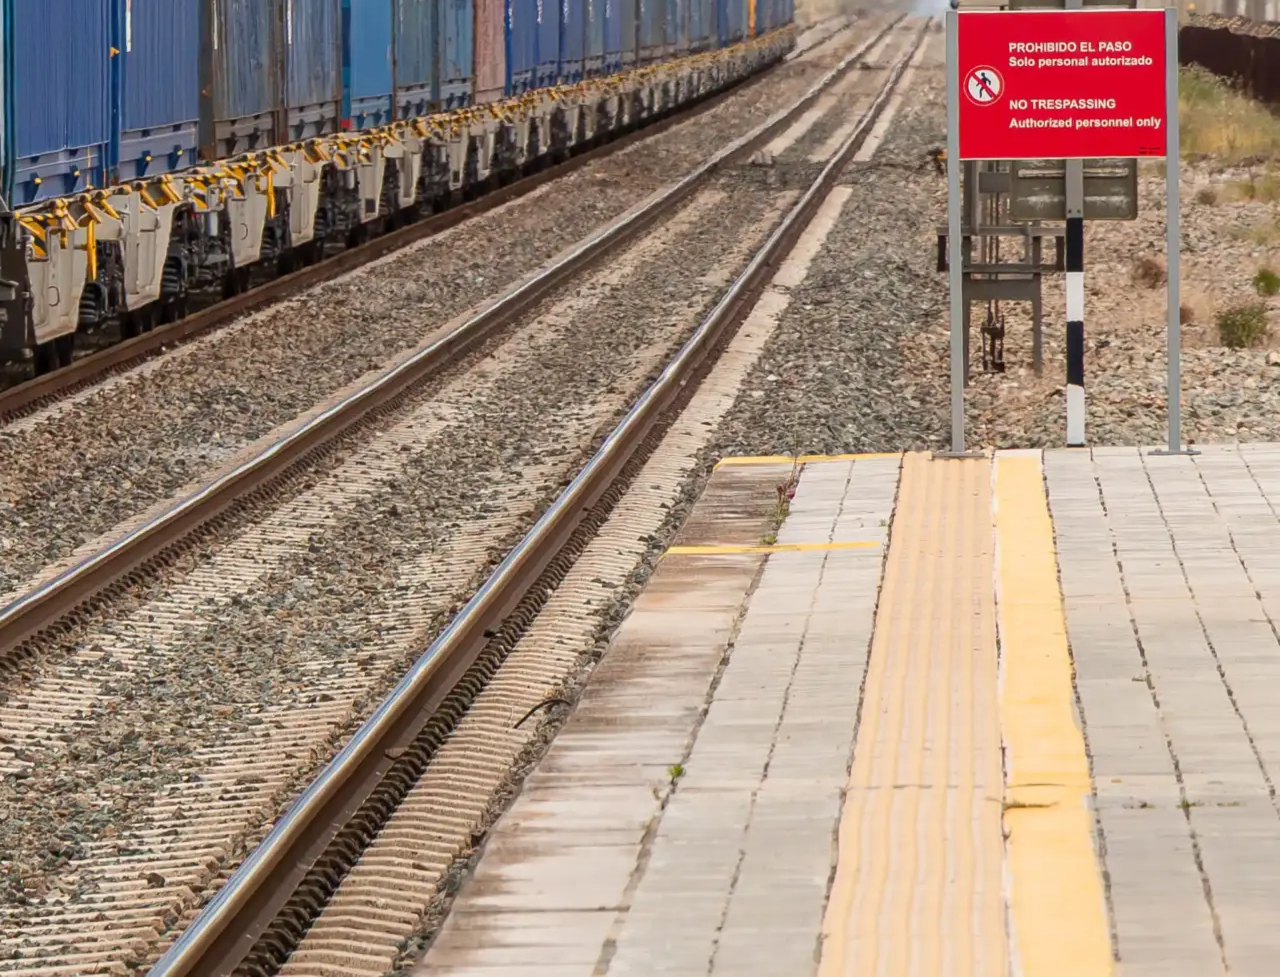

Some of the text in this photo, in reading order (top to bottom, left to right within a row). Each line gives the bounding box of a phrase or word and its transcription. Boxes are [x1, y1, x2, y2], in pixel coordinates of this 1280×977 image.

[1008, 40, 1132, 53] PROHIBIDO EL PASO
[1008, 55, 1153, 69] Solo personal autorizado
[1009, 98, 1116, 110] NO TRESPASSING
[1008, 116, 1161, 130] Authorized personnel only
